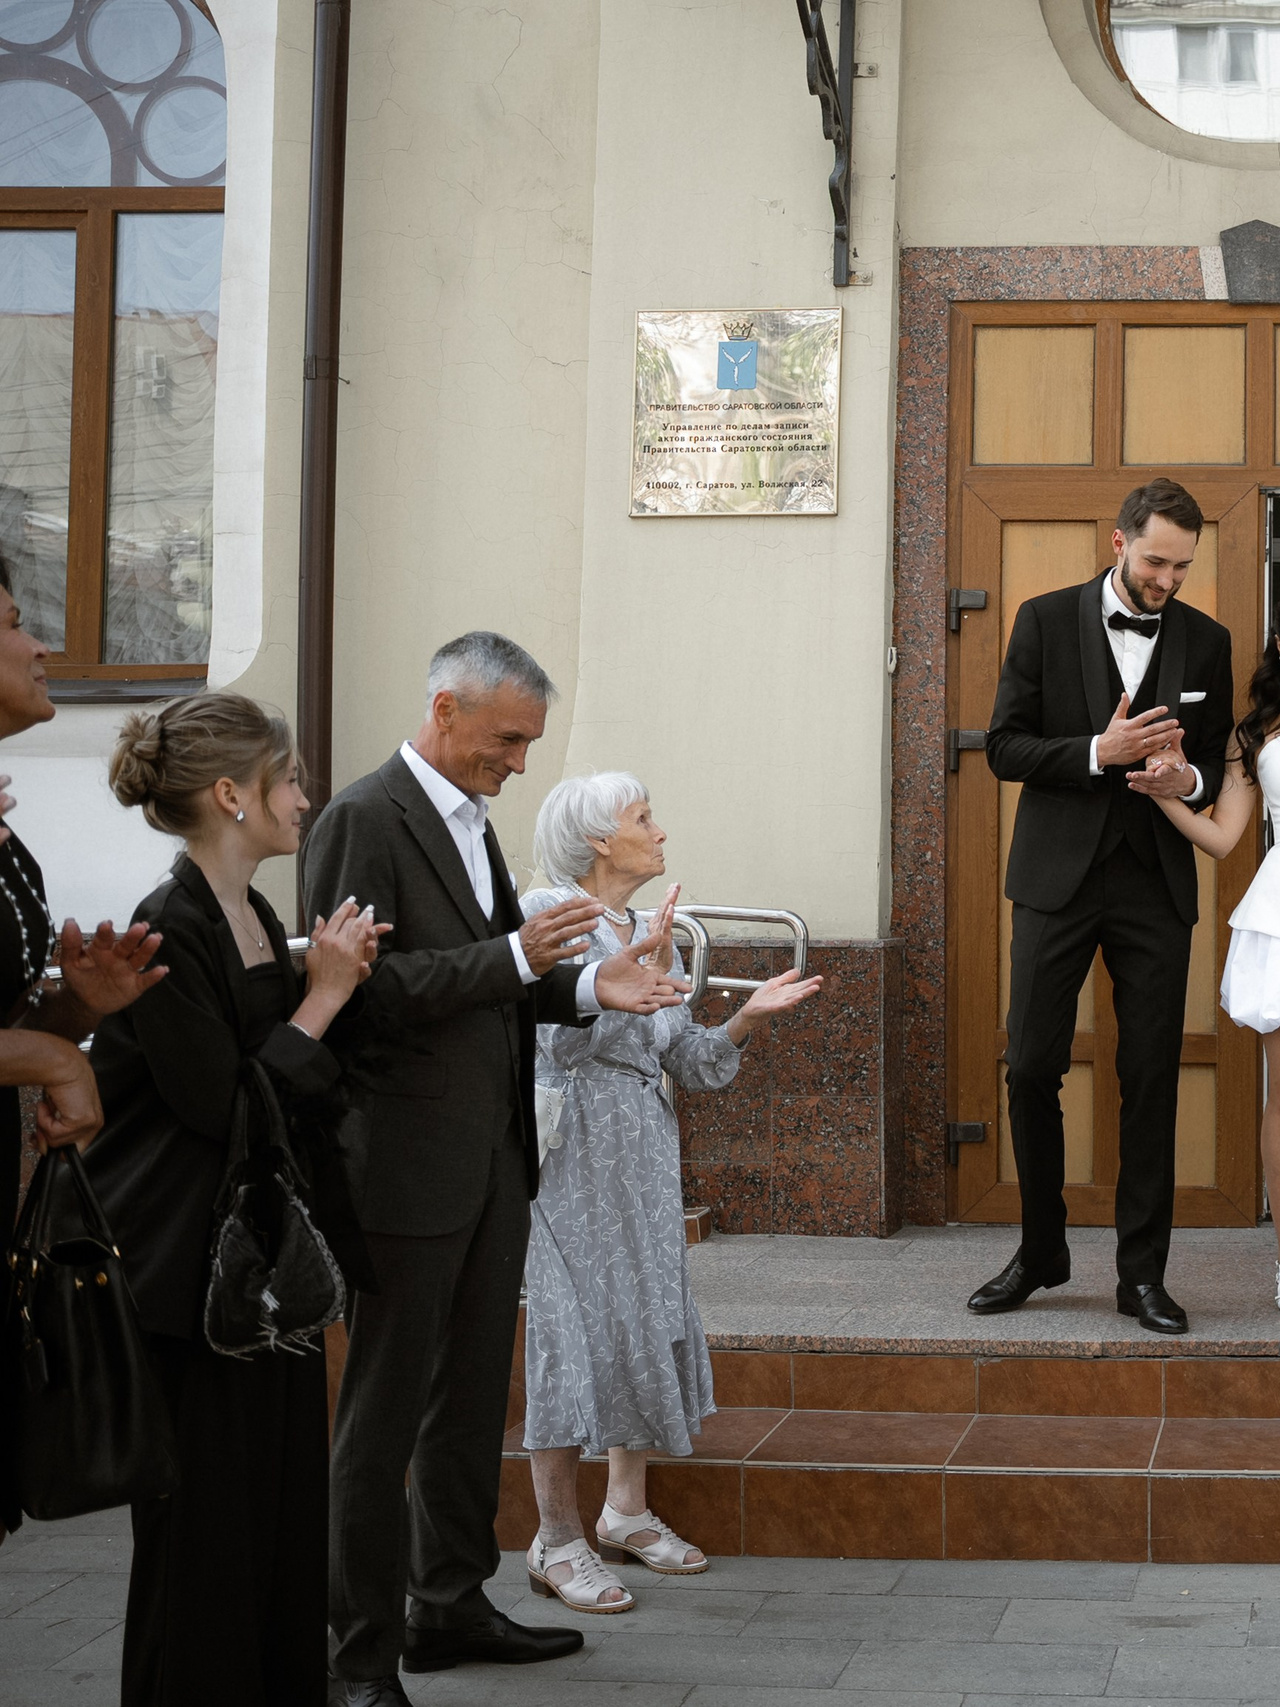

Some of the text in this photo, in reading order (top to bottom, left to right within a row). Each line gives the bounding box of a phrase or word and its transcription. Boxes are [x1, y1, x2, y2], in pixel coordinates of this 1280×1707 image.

[649, 402, 824, 411] ПРАВИТЕЛЬСТВО САРАТОВСКОЙ ОБЛАСТИ
[662, 422, 809, 432] Управление по делам записи
[689, 434, 759, 443] гражданского
[761, 433, 813, 441] состояния
[643, 444, 828, 455] Правительства Саратовской области
[645, 482, 682, 490] 410002,
[696, 481, 738, 490] Саратов,
[741, 482, 755, 490] ул.
[811, 480, 824, 488] 22
